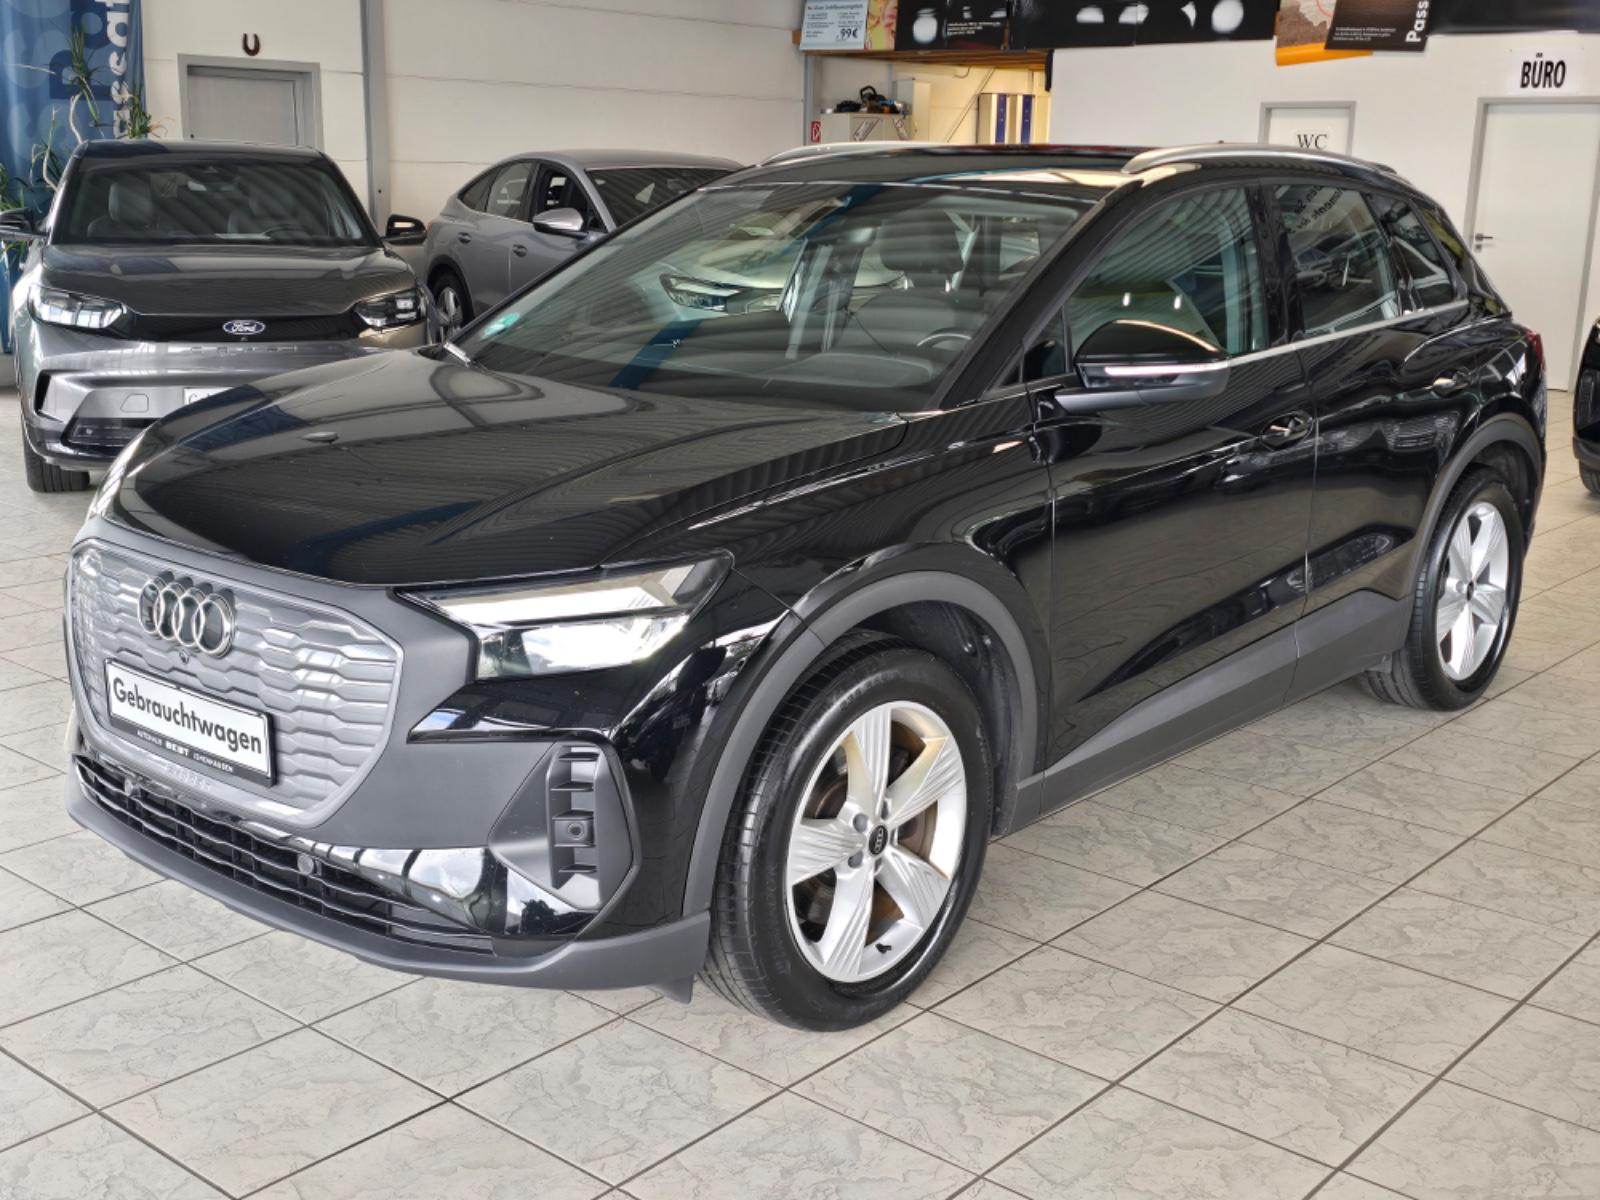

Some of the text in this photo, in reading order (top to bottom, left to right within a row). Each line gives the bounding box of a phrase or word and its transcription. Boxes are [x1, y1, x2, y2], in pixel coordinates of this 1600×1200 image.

[1405, 0, 1430, 42] Pass
[1520, 52, 1566, 89] BÜRO
[1297, 134, 1328, 149] WC
[113, 677, 262, 754] Gebrauchtwagen
[165, 741, 189, 756] BEST
